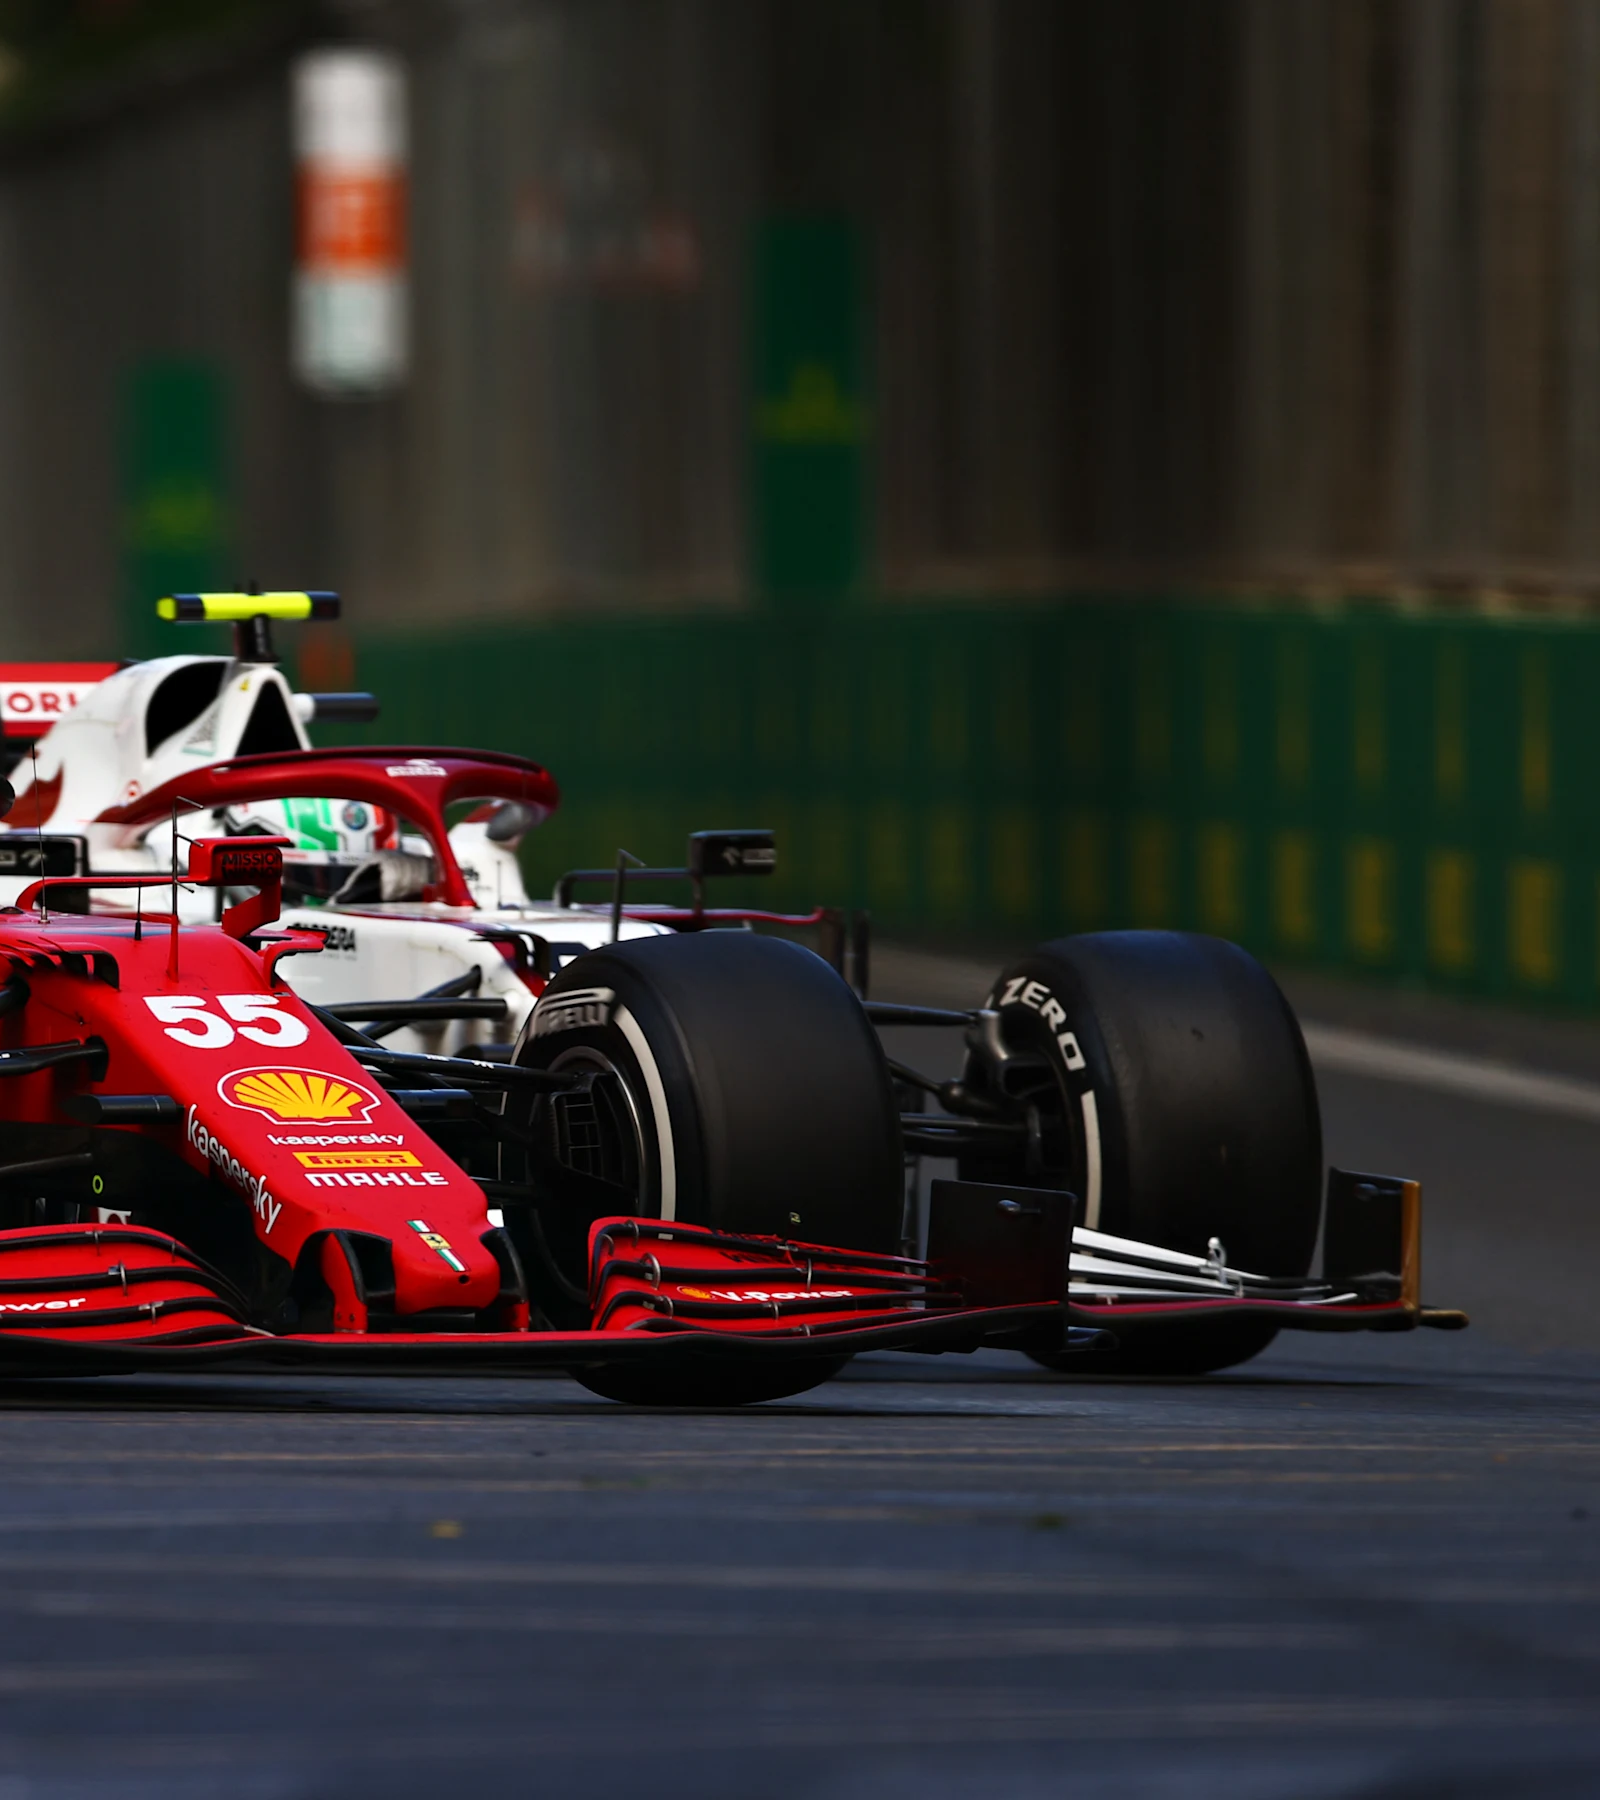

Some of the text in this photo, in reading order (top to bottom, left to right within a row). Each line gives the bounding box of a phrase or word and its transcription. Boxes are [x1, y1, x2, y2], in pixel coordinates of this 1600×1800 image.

[143, 994, 310, 1050] 55
[999, 977, 1087, 1072] ZERO
[267, 1132, 405, 1147] kaspersky
[306, 1155, 406, 1166] PIRELLI
[187, 1103, 282, 1235] kaspersky
[304, 1171, 449, 1187] MAHLE
[710, 1289, 854, 1303] V-Power
